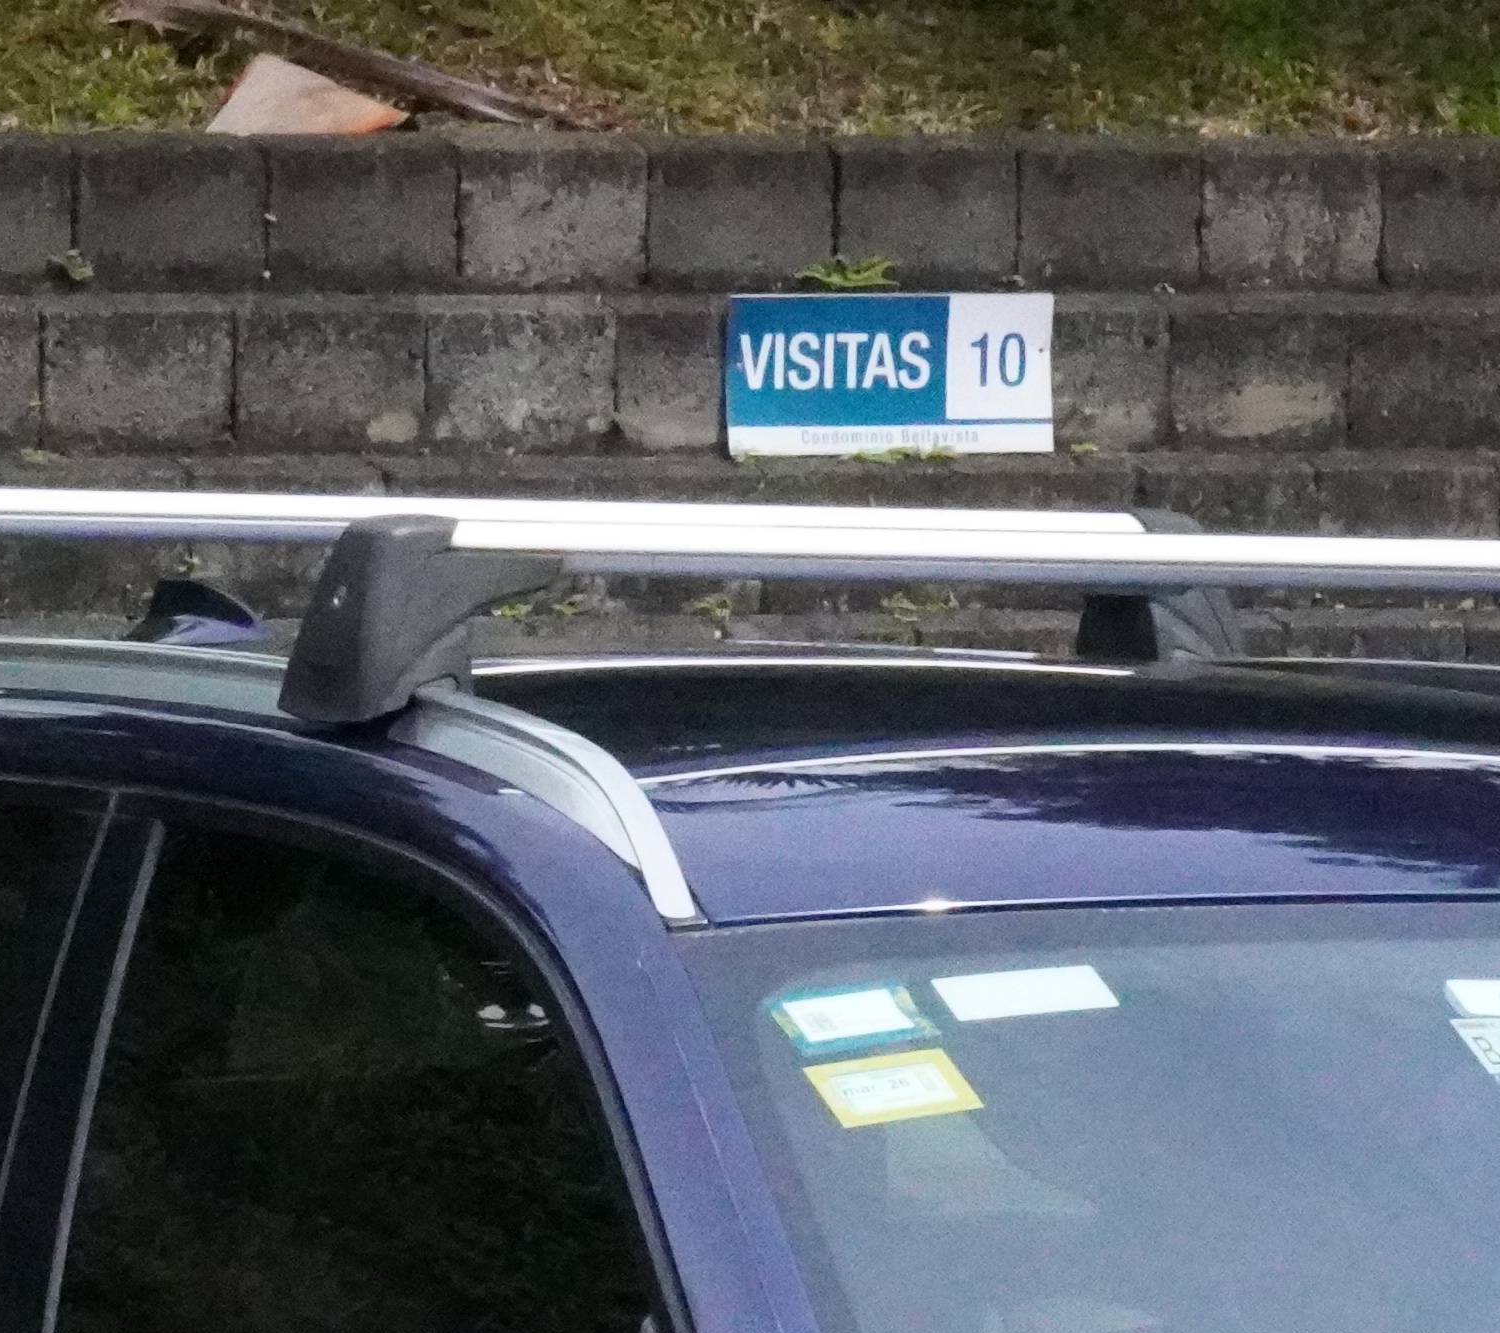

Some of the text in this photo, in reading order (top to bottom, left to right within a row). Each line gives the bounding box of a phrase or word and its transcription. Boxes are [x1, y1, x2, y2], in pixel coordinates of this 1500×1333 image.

[739, 331, 1027, 391] VISITAS 10
[801, 428, 980, 445] Condominio Bellavista
